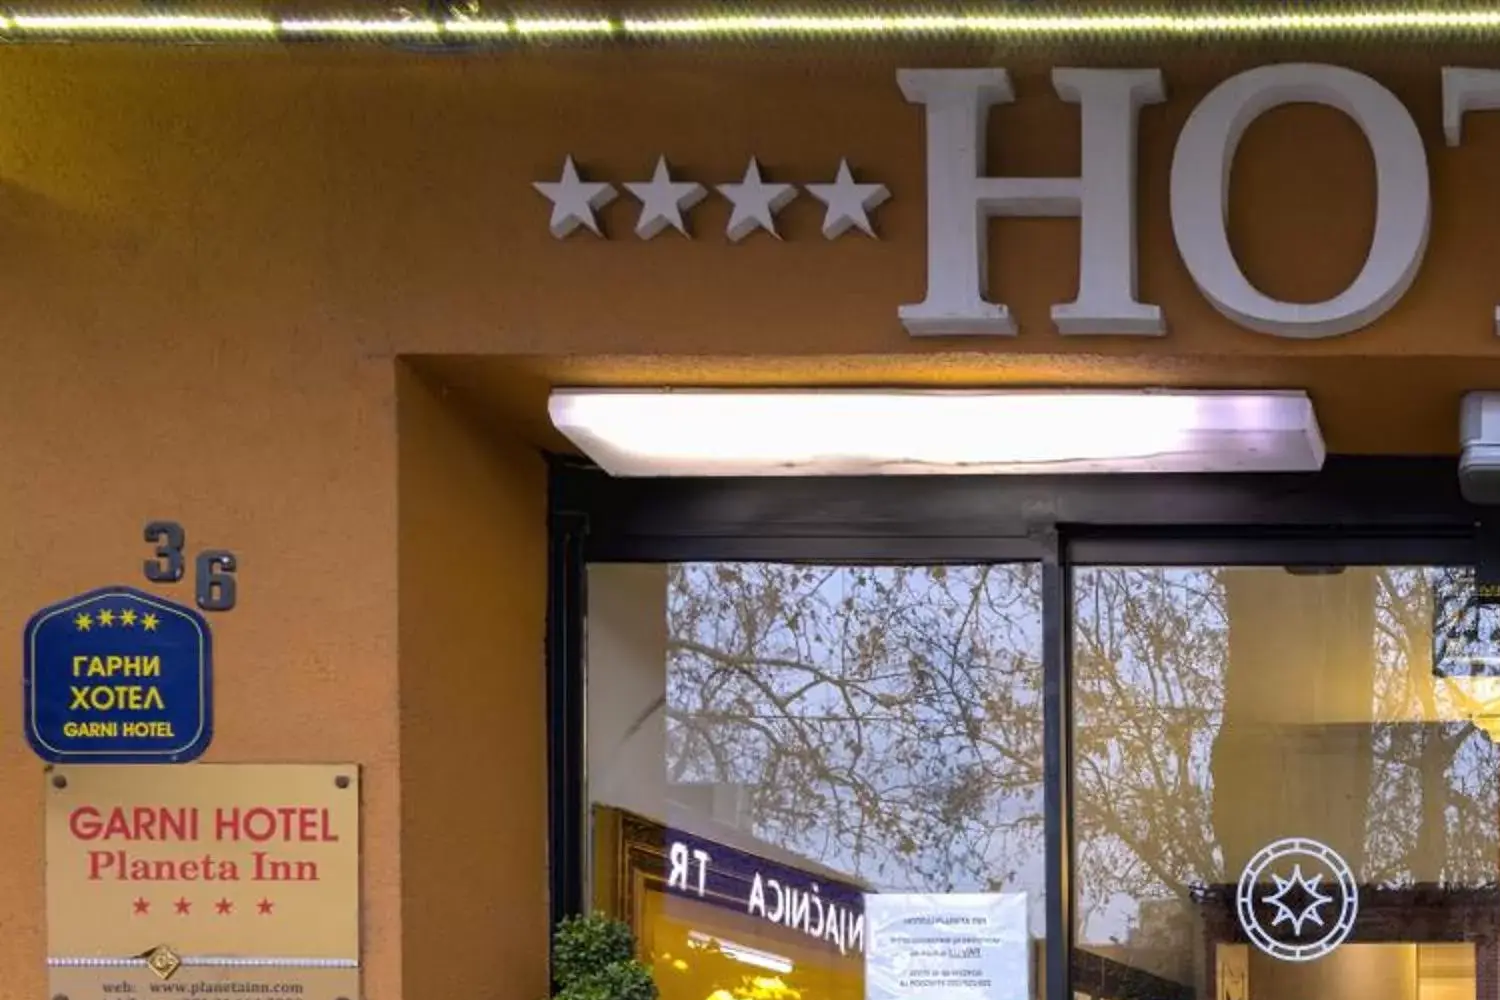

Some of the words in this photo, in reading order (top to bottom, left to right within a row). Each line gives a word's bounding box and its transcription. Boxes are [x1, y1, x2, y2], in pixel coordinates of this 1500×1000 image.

[143, 519, 237, 612] 36
[72, 655, 161, 677] ГАРНИ
[69, 686, 166, 711] ХОТЕЛ
[63, 722, 117, 737] GARNI
[122, 722, 175, 737] HOTEL
[69, 806, 199, 841] GARNI
[215, 807, 339, 842] HOTEL
[87, 850, 240, 881] Planeta
[251, 852, 320, 881] Inn
